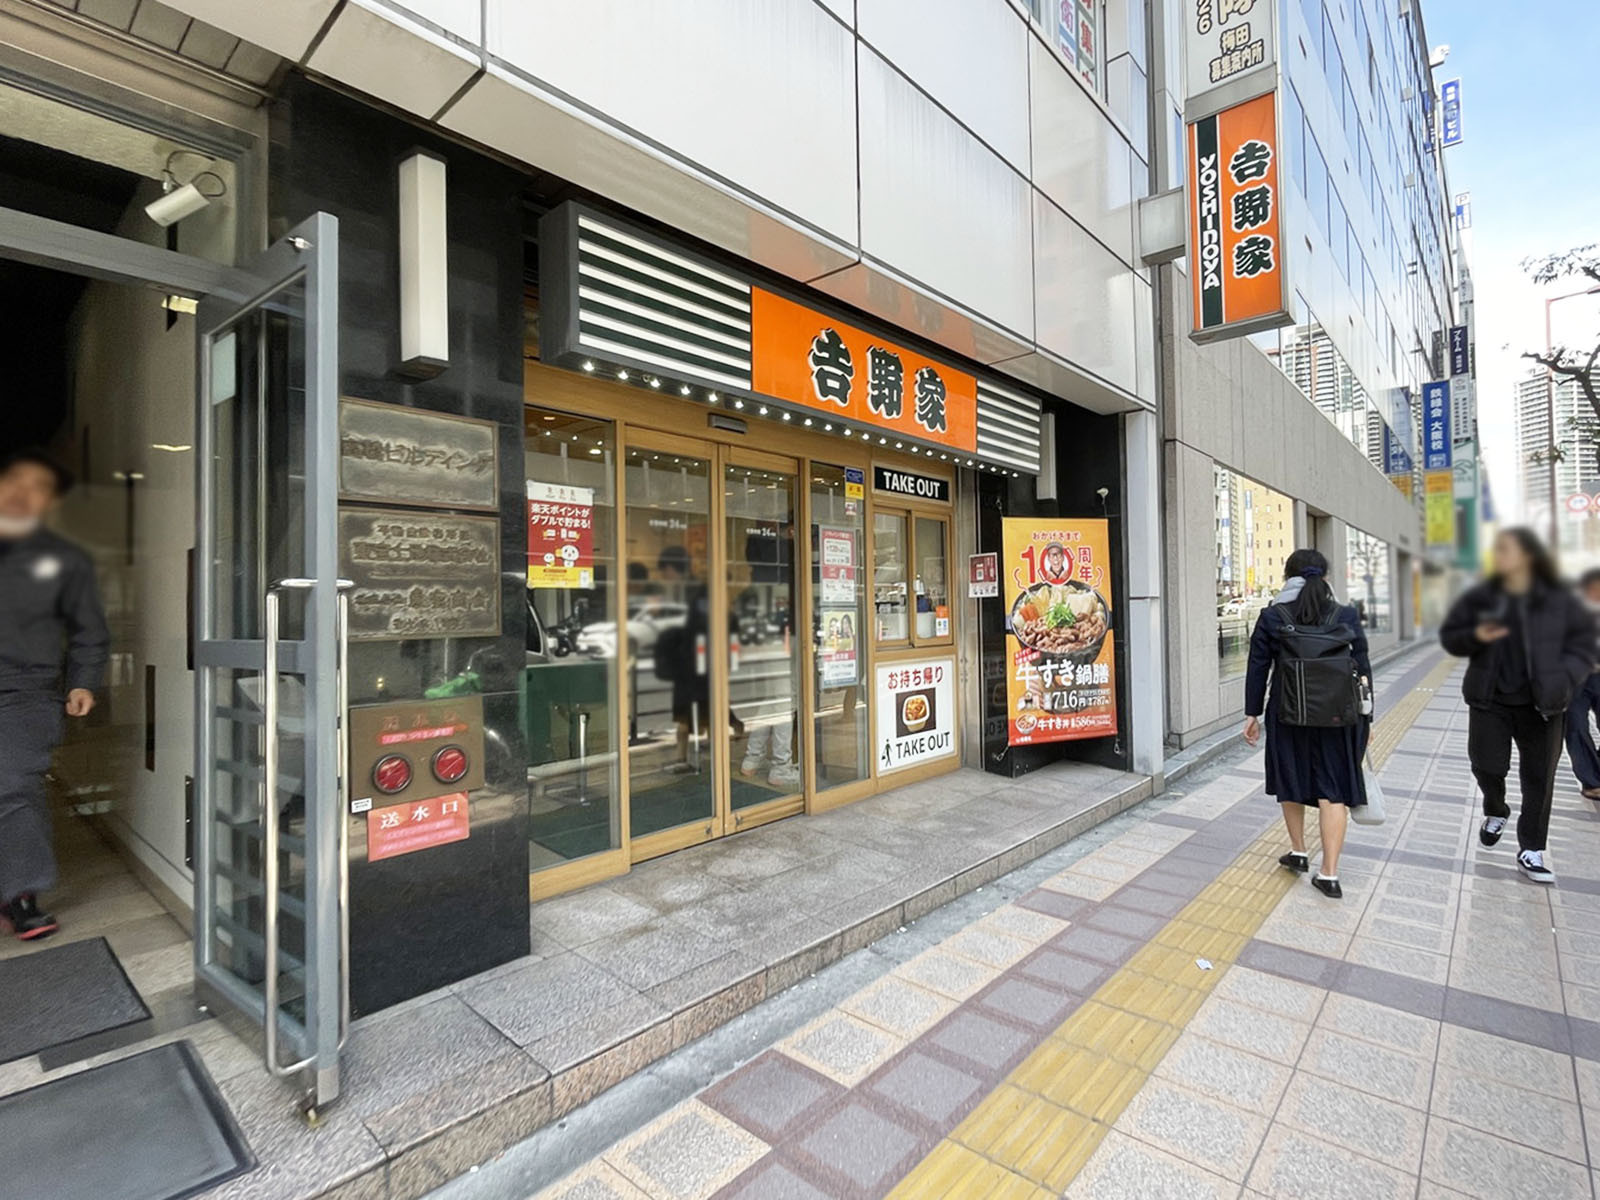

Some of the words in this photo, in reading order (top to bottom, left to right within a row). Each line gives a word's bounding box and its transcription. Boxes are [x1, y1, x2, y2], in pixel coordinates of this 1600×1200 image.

[1220, 22, 1250, 56] 梅田
[1209, 39, 1263, 83] 募集案内所
[1229, 139, 1275, 279] 吉野家
[808, 327, 947, 433] 吉野家
[883, 471, 915, 494] TAKE
[917, 478, 941, 498] OUT
[531, 503, 591, 518] 楽天ポイントが
[1032, 530, 1081, 542] おかげさまで
[887, 666, 944, 690] お持ち帰り
[1015, 658, 1109, 690] 牛すき鍋膳
[896, 737, 926, 759] TAKE
[927, 731, 951, 751] OUT
[380, 799, 459, 830] 送水口
